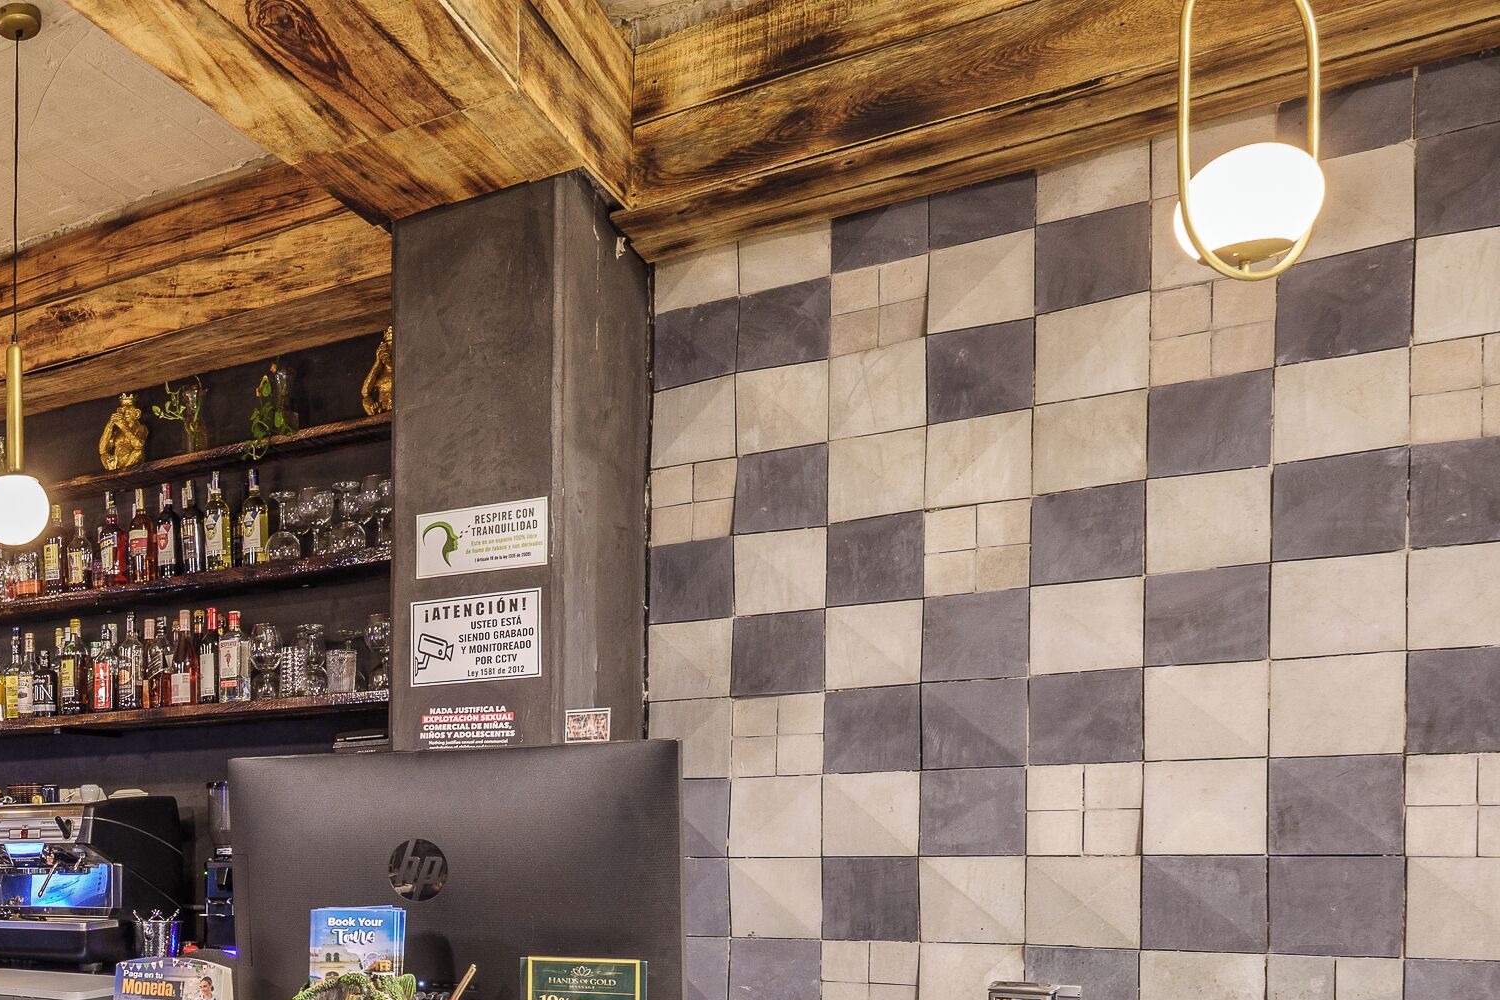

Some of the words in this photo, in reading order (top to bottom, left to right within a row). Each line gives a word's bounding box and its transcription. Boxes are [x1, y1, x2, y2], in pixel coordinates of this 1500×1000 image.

[474, 510, 513, 525] RESPIRE
[516, 507, 535, 519] CON
[471, 519, 538, 537] TRANQUILIDAD
[424, 597, 527, 623] ¡ATENCIÓN!
[470, 619, 498, 630] USTED
[500, 615, 522, 627] ESTÁ
[458, 632, 491, 643] SIENDO
[493, 627, 534, 640] GRABADO
[460, 646, 467, 654] Y
[469, 640, 532, 654] MONITOREADO
[475, 656, 493, 665] POR
[495, 653, 518, 664] CCTV
[467, 669, 479, 677] Ley
[480, 667, 496, 676] 1581
[497, 667, 506, 675] de
[507, 665, 525, 674] 2012
[429, 707, 453, 715] NADA
[454, 706, 494, 714] JUSTIFICA
[495, 705, 507, 713] LA
[423, 714, 480, 723] EXPLOTACIÓN
[480, 713, 513, 721] SEXUAL
[423, 723, 470, 731] COMERCIAL
[483, 721, 512, 730] NIÑAS,
[419, 731, 446, 739] NIÑOS
[453, 730, 516, 738] ADOLESCENTES
[394, 840, 444, 900] hp
[327, 917, 355, 927] Book
[357, 918, 383, 927] Your
[331, 928, 375, 945] Tours
[123, 969, 143, 979] Paga
[548, 977, 579, 985] HANDS
[589, 978, 617, 987] GOLD
